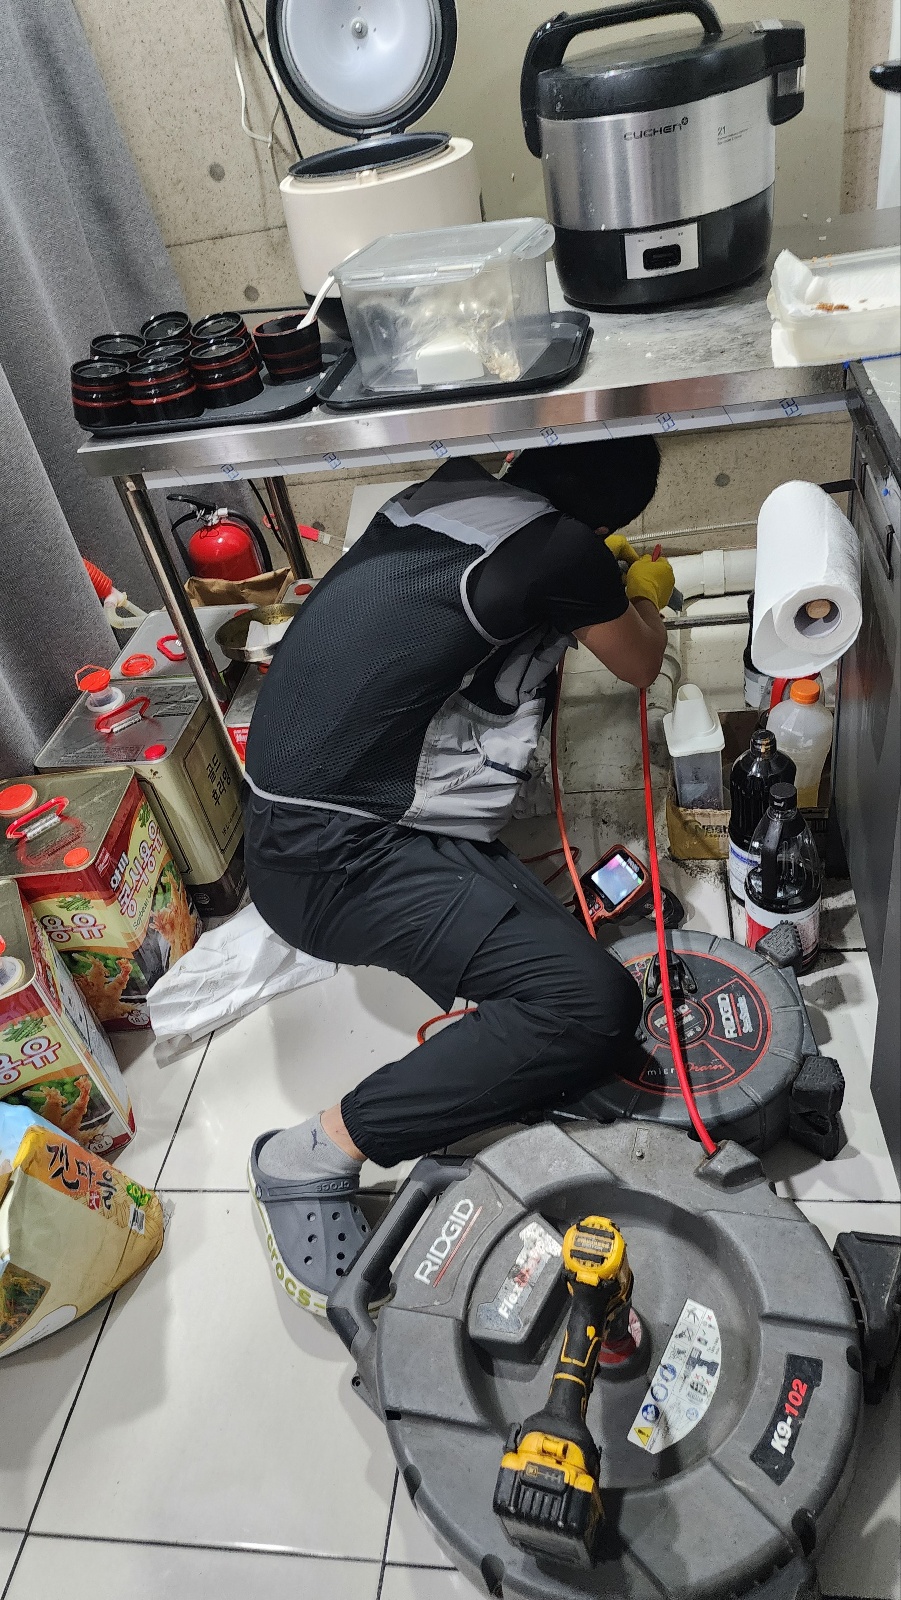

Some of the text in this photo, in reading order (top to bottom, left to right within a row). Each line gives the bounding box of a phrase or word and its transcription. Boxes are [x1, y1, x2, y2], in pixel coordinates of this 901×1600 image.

[206, 753, 221, 784] 골드
[117, 820, 163, 918] 콩식용유
[266, 1233, 312, 1307] crocs
[414, 1199, 474, 1285] RIDGID
[770, 1378, 808, 1455] K9-102
